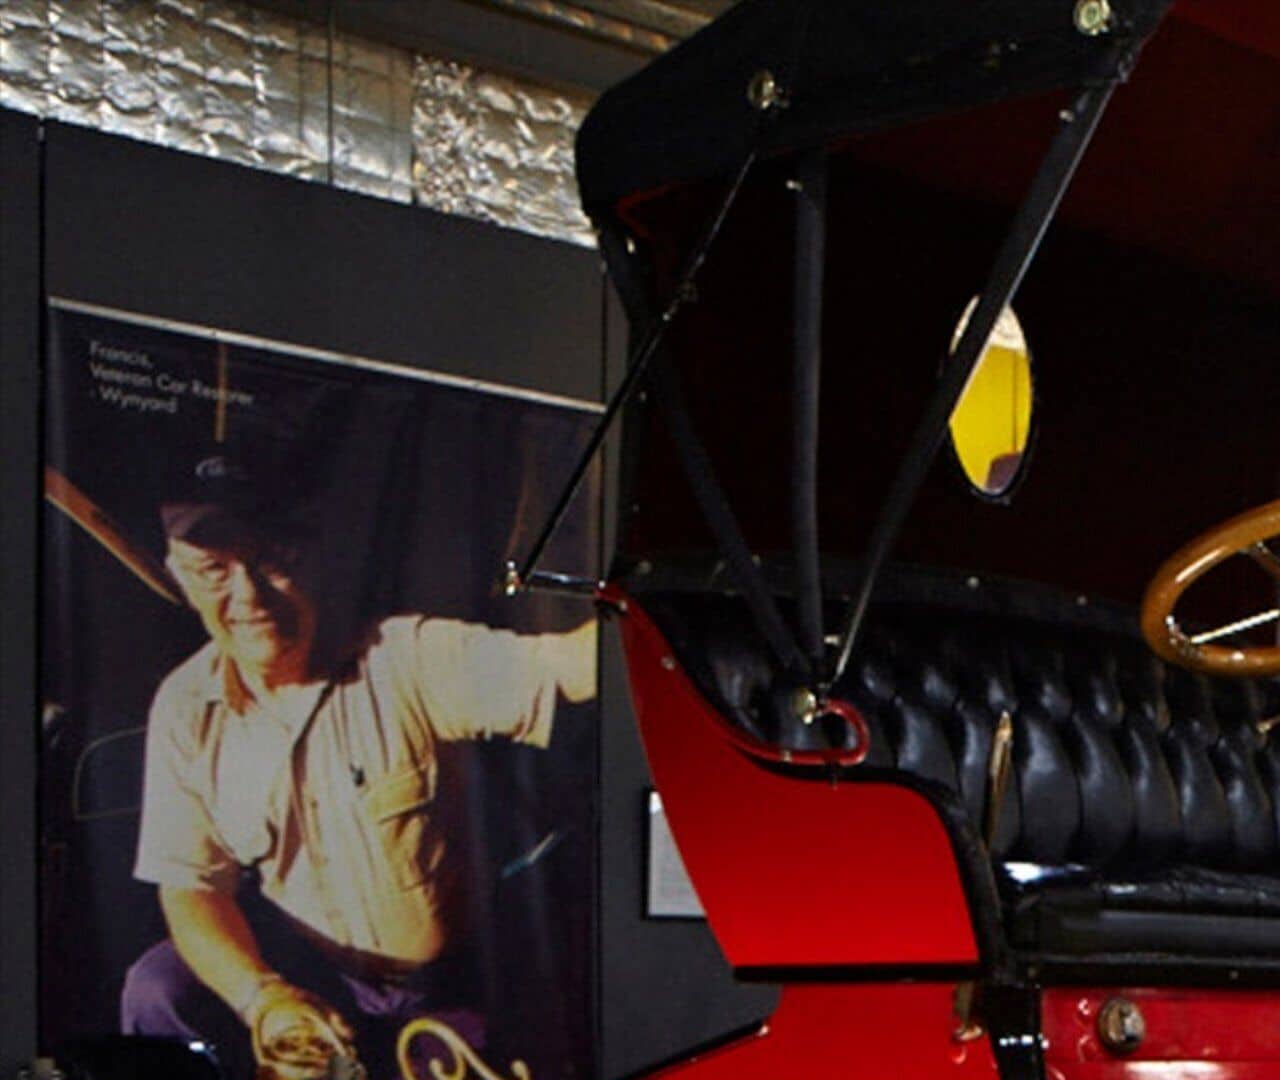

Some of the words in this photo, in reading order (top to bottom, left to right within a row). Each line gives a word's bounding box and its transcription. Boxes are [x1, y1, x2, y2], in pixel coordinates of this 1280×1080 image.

[89, 362, 153, 388] Veteran
[157, 373, 188, 394] Car
[100, 384, 177, 414] Wynyard
